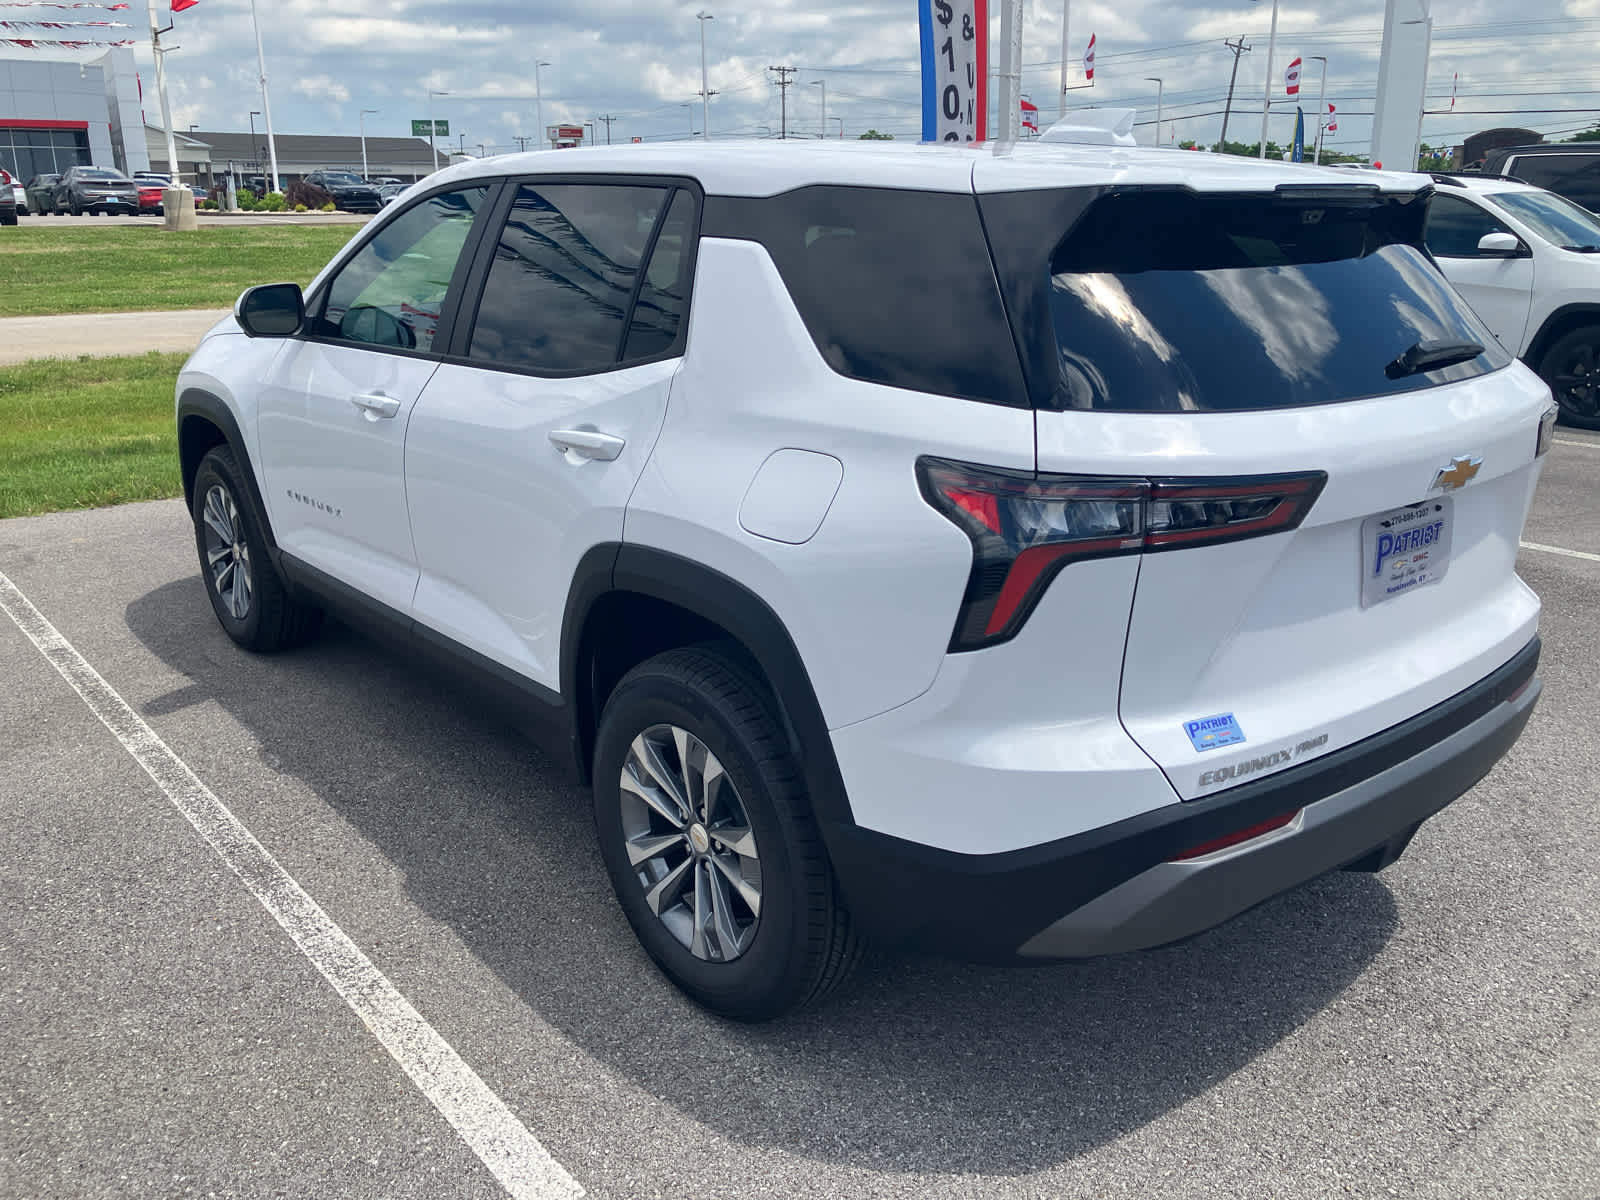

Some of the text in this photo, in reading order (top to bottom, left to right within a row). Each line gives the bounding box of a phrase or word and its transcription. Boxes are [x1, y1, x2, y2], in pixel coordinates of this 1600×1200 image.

[962, 14, 974, 41] &
[935, 0, 963, 141] $10,
[1199, 747, 1294, 786] EQUINOX
